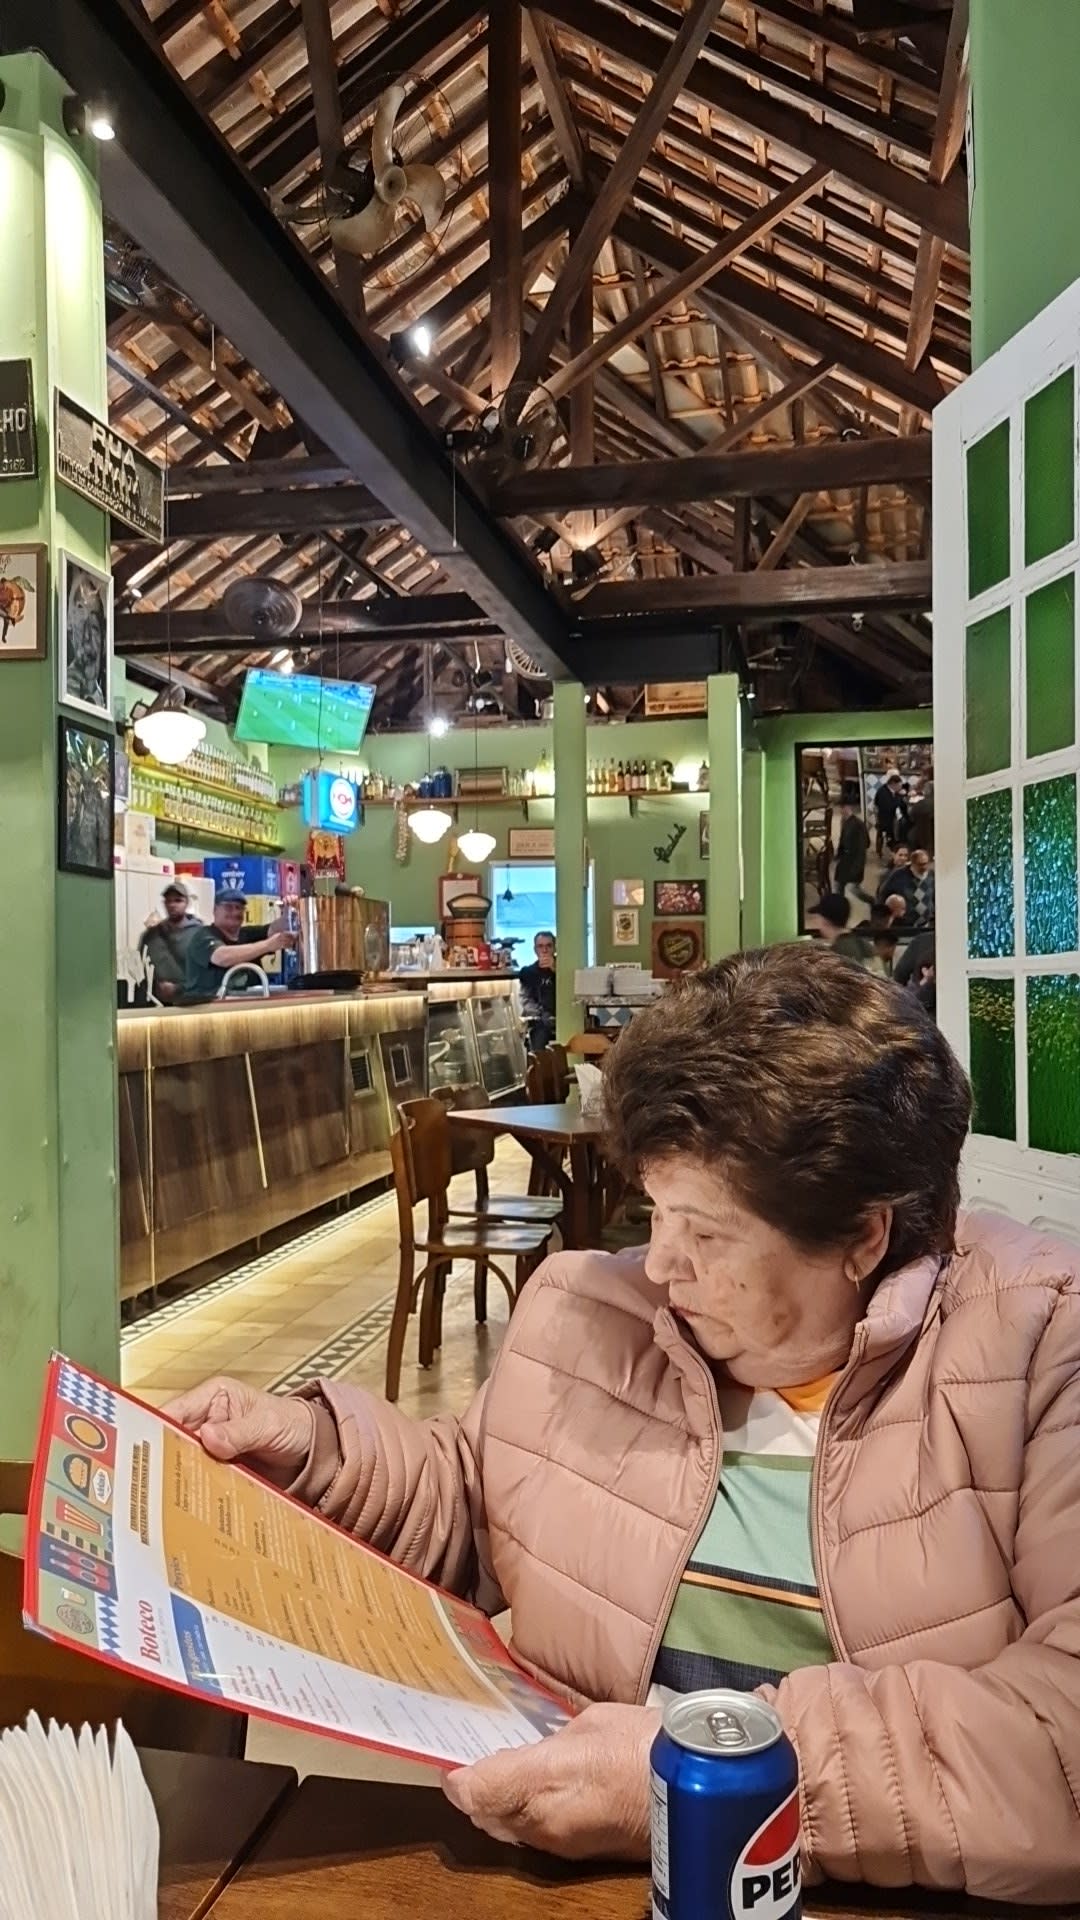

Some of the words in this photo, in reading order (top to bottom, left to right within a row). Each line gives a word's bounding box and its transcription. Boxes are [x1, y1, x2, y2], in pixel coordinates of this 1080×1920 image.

[0, 408, 27, 432] HO
[92, 421, 137, 468] RUA
[139, 1600, 160, 1664] Boteco
